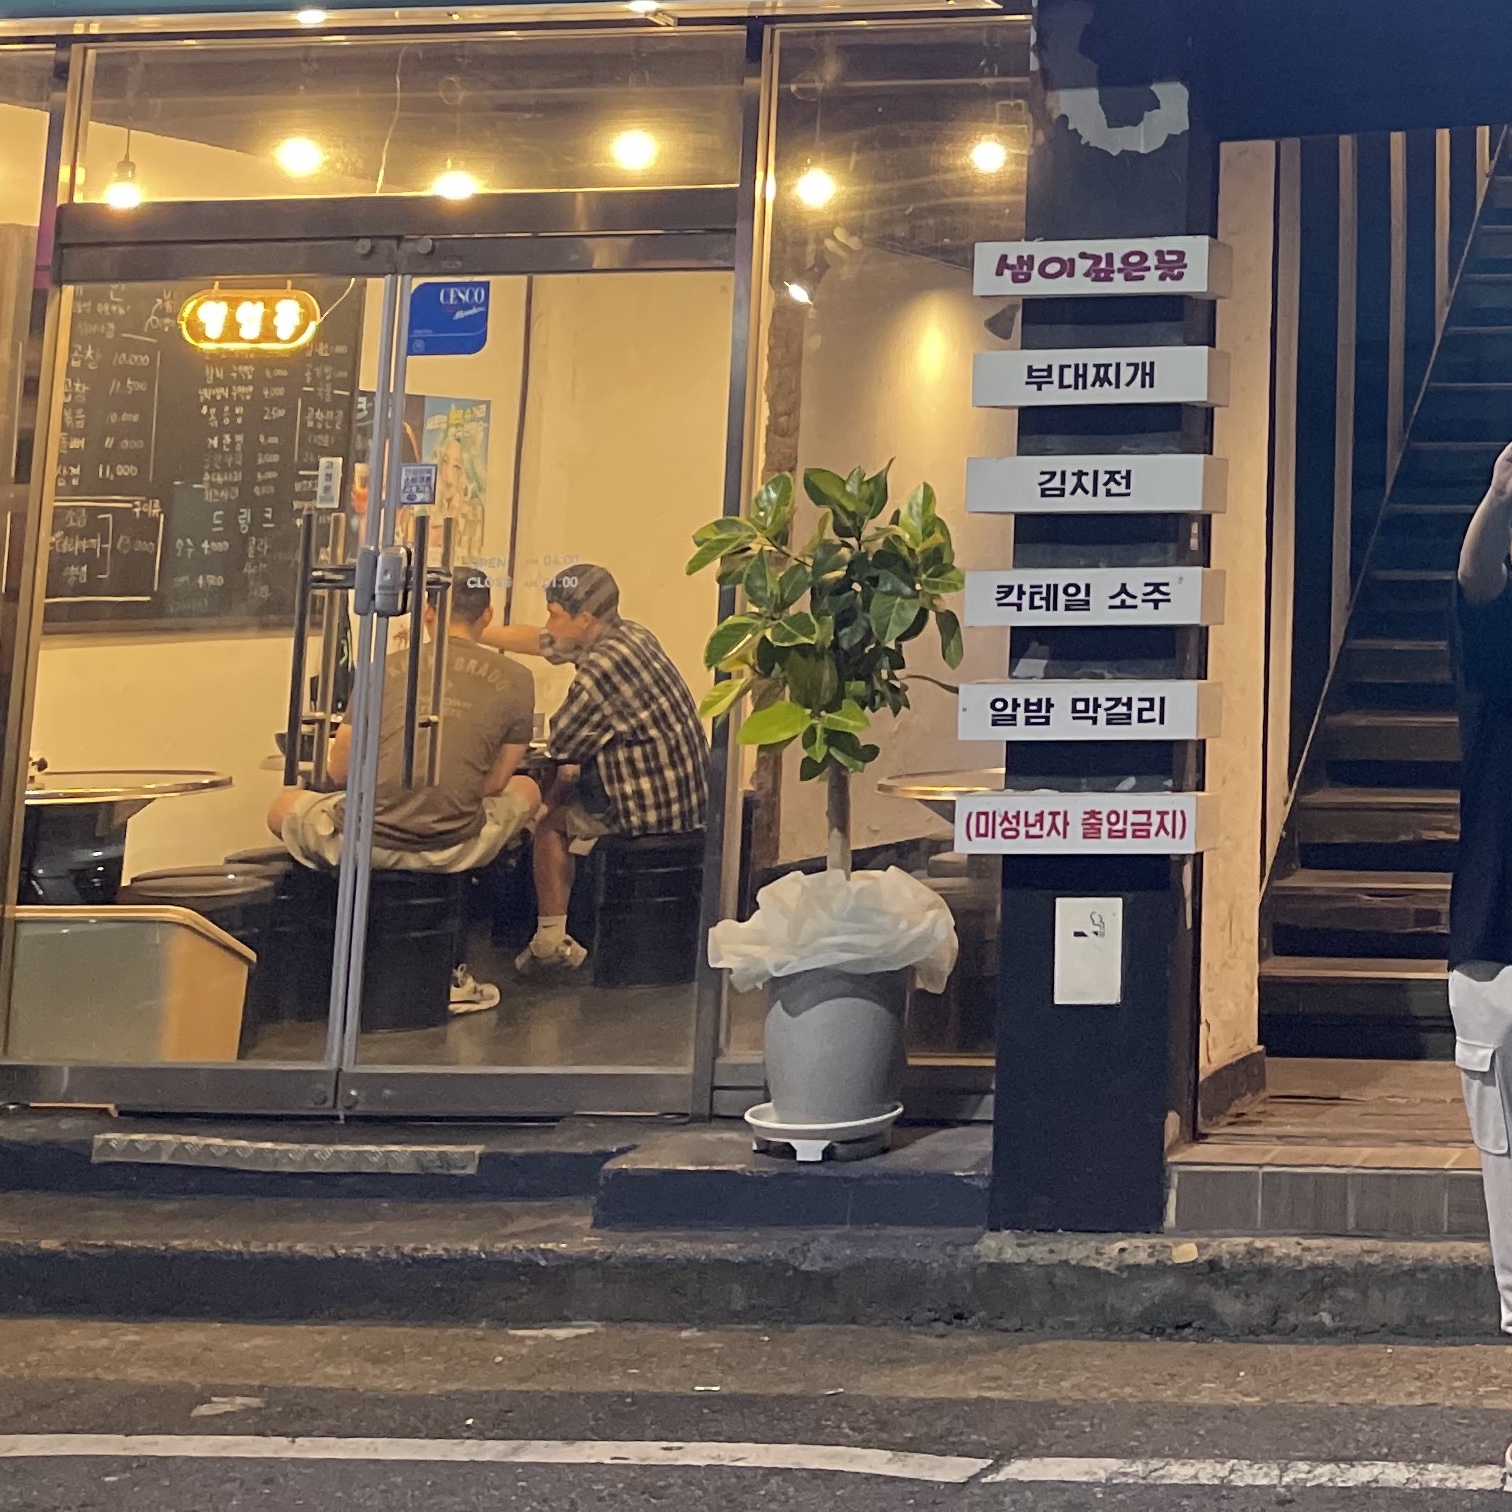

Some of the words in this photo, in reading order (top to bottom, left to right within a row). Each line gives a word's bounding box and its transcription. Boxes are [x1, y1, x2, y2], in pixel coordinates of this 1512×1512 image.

[439, 287, 485, 306] CESCO
[1024, 360, 1155, 392] 부대찌개
[1037, 469, 1132, 499] 김치전
[994, 582, 1091, 612] 칵테일
[1107, 581, 1172, 611] 소주
[989, 697, 1055, 727] 알밤
[1070, 696, 1166, 726] 막걸리
[965, 809, 1070, 842] (미성년자
[1080, 809, 1187, 840] 출입금지)
